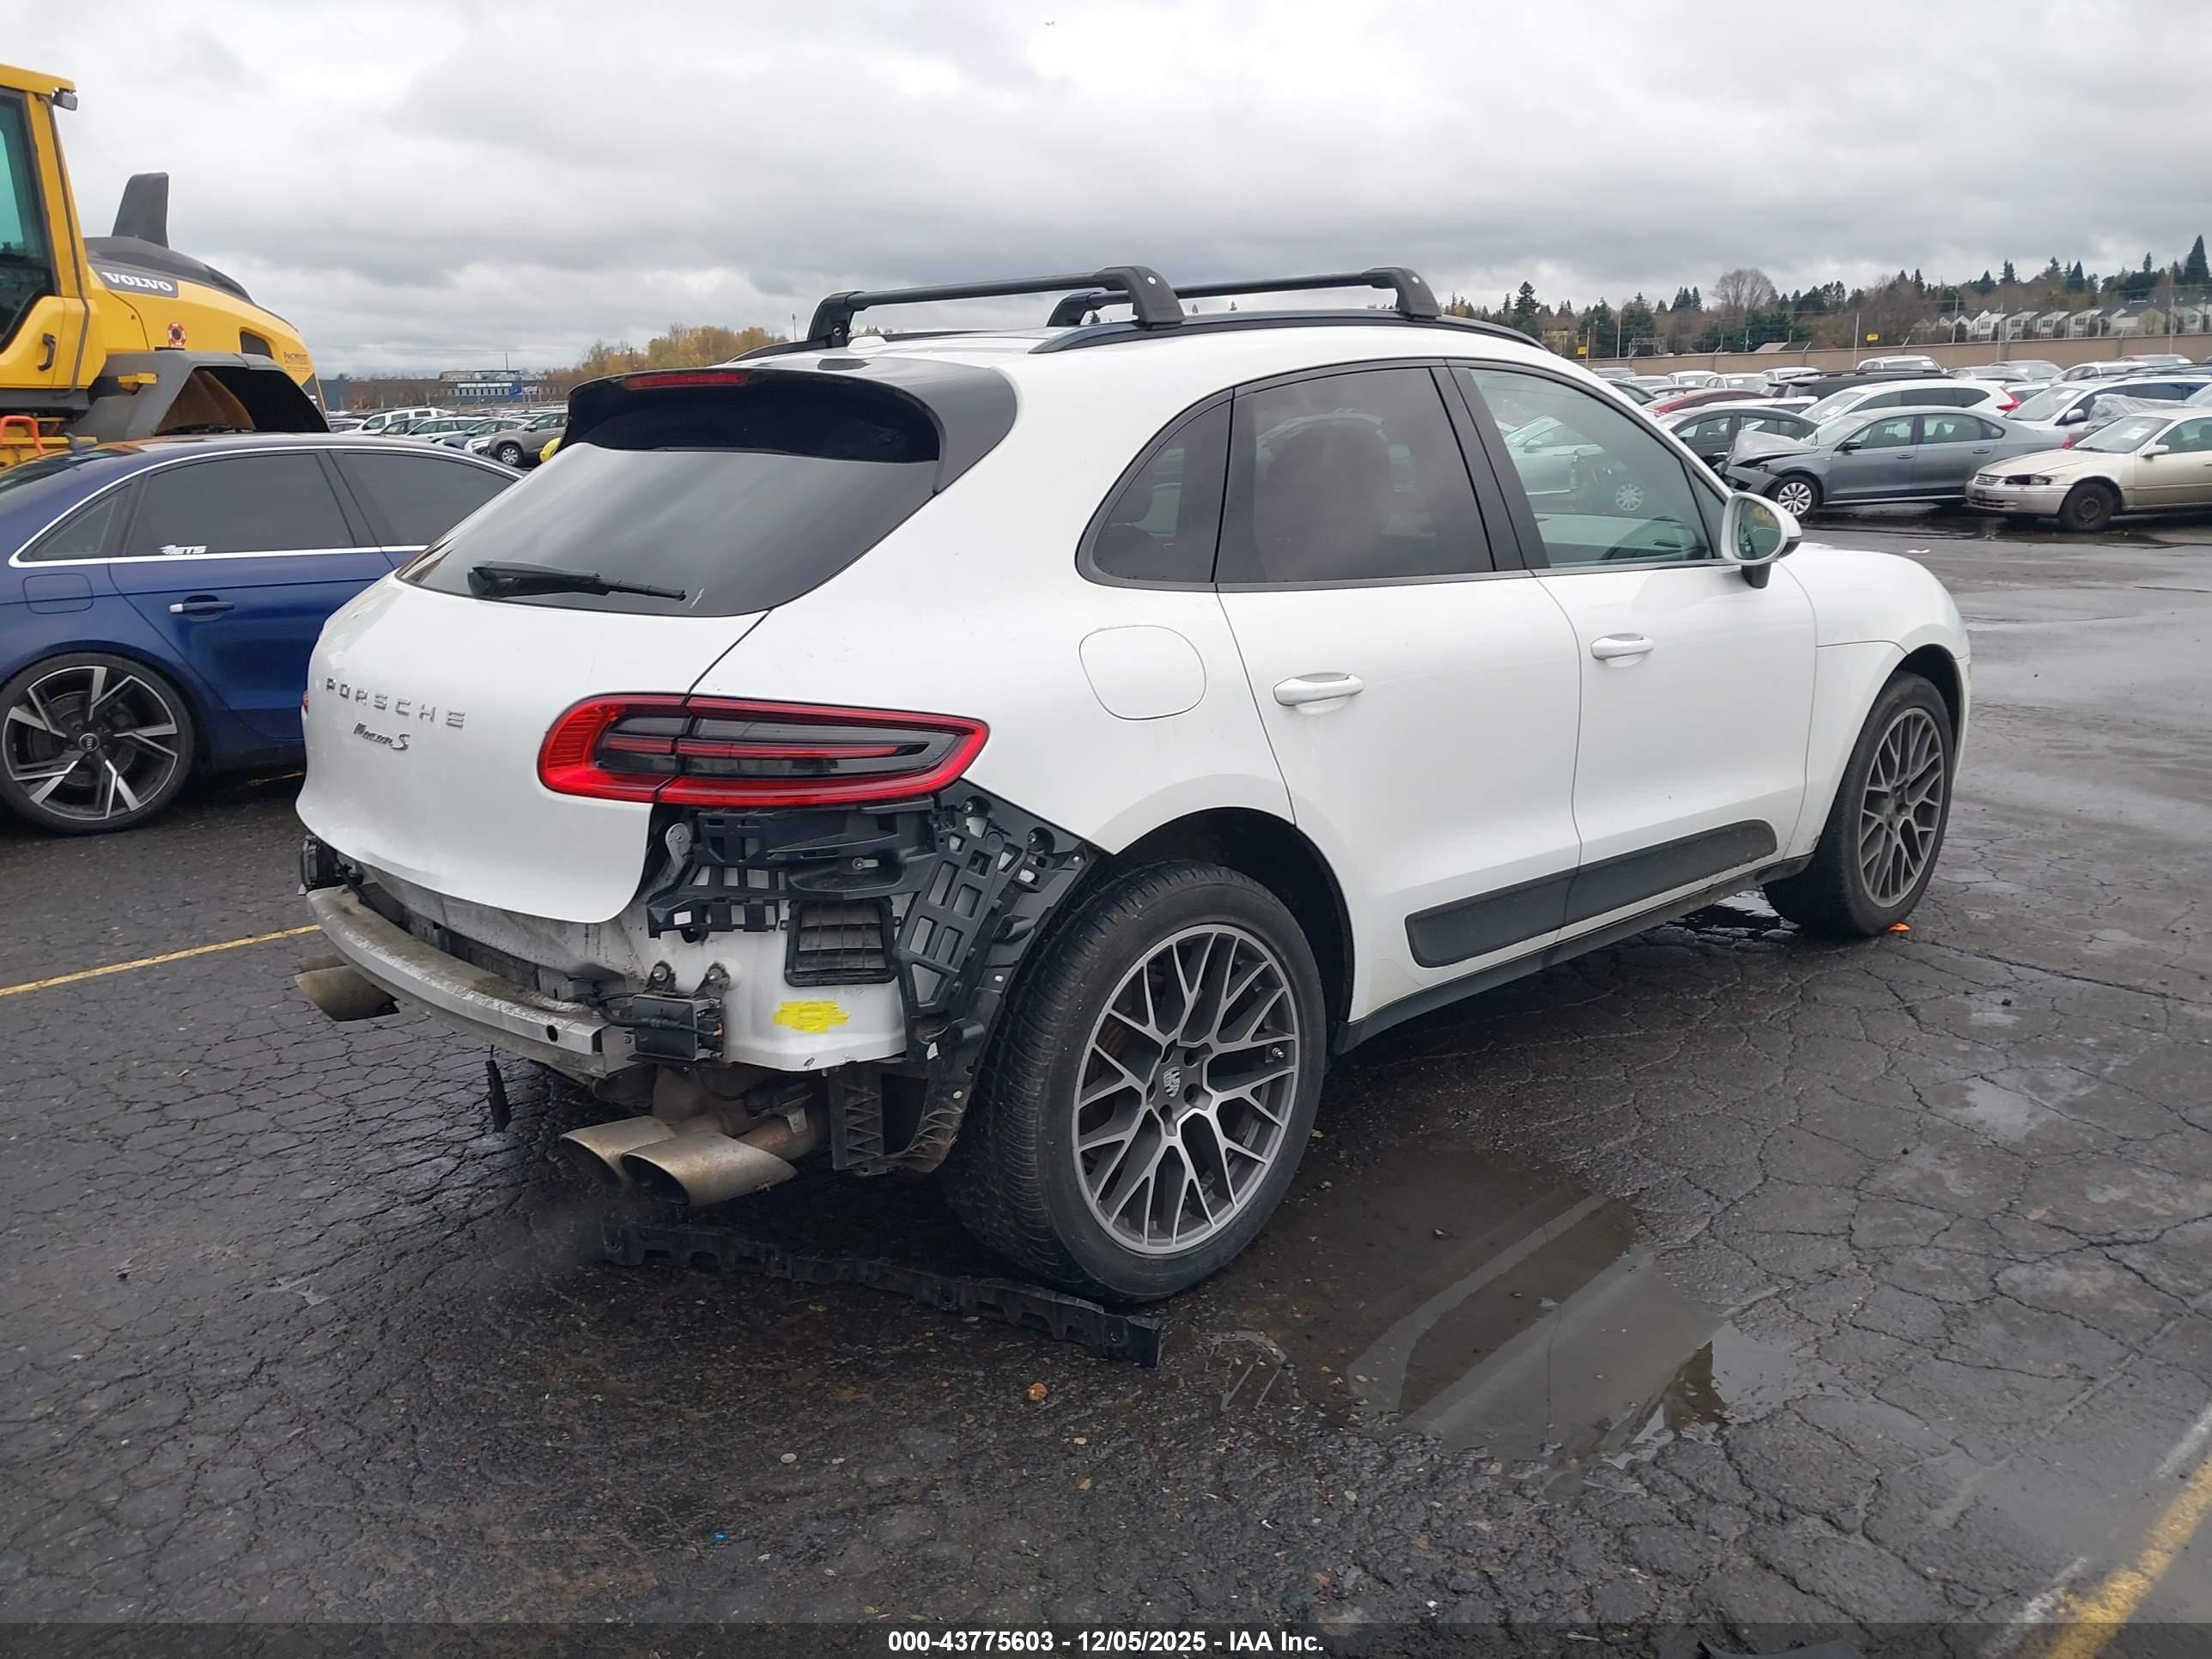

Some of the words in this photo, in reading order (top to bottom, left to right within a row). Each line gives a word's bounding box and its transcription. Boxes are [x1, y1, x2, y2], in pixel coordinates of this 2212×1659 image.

[101, 271, 173, 291] VOLVO
[326, 678, 465, 728] PORSCHE
[391, 733, 410, 750] S
